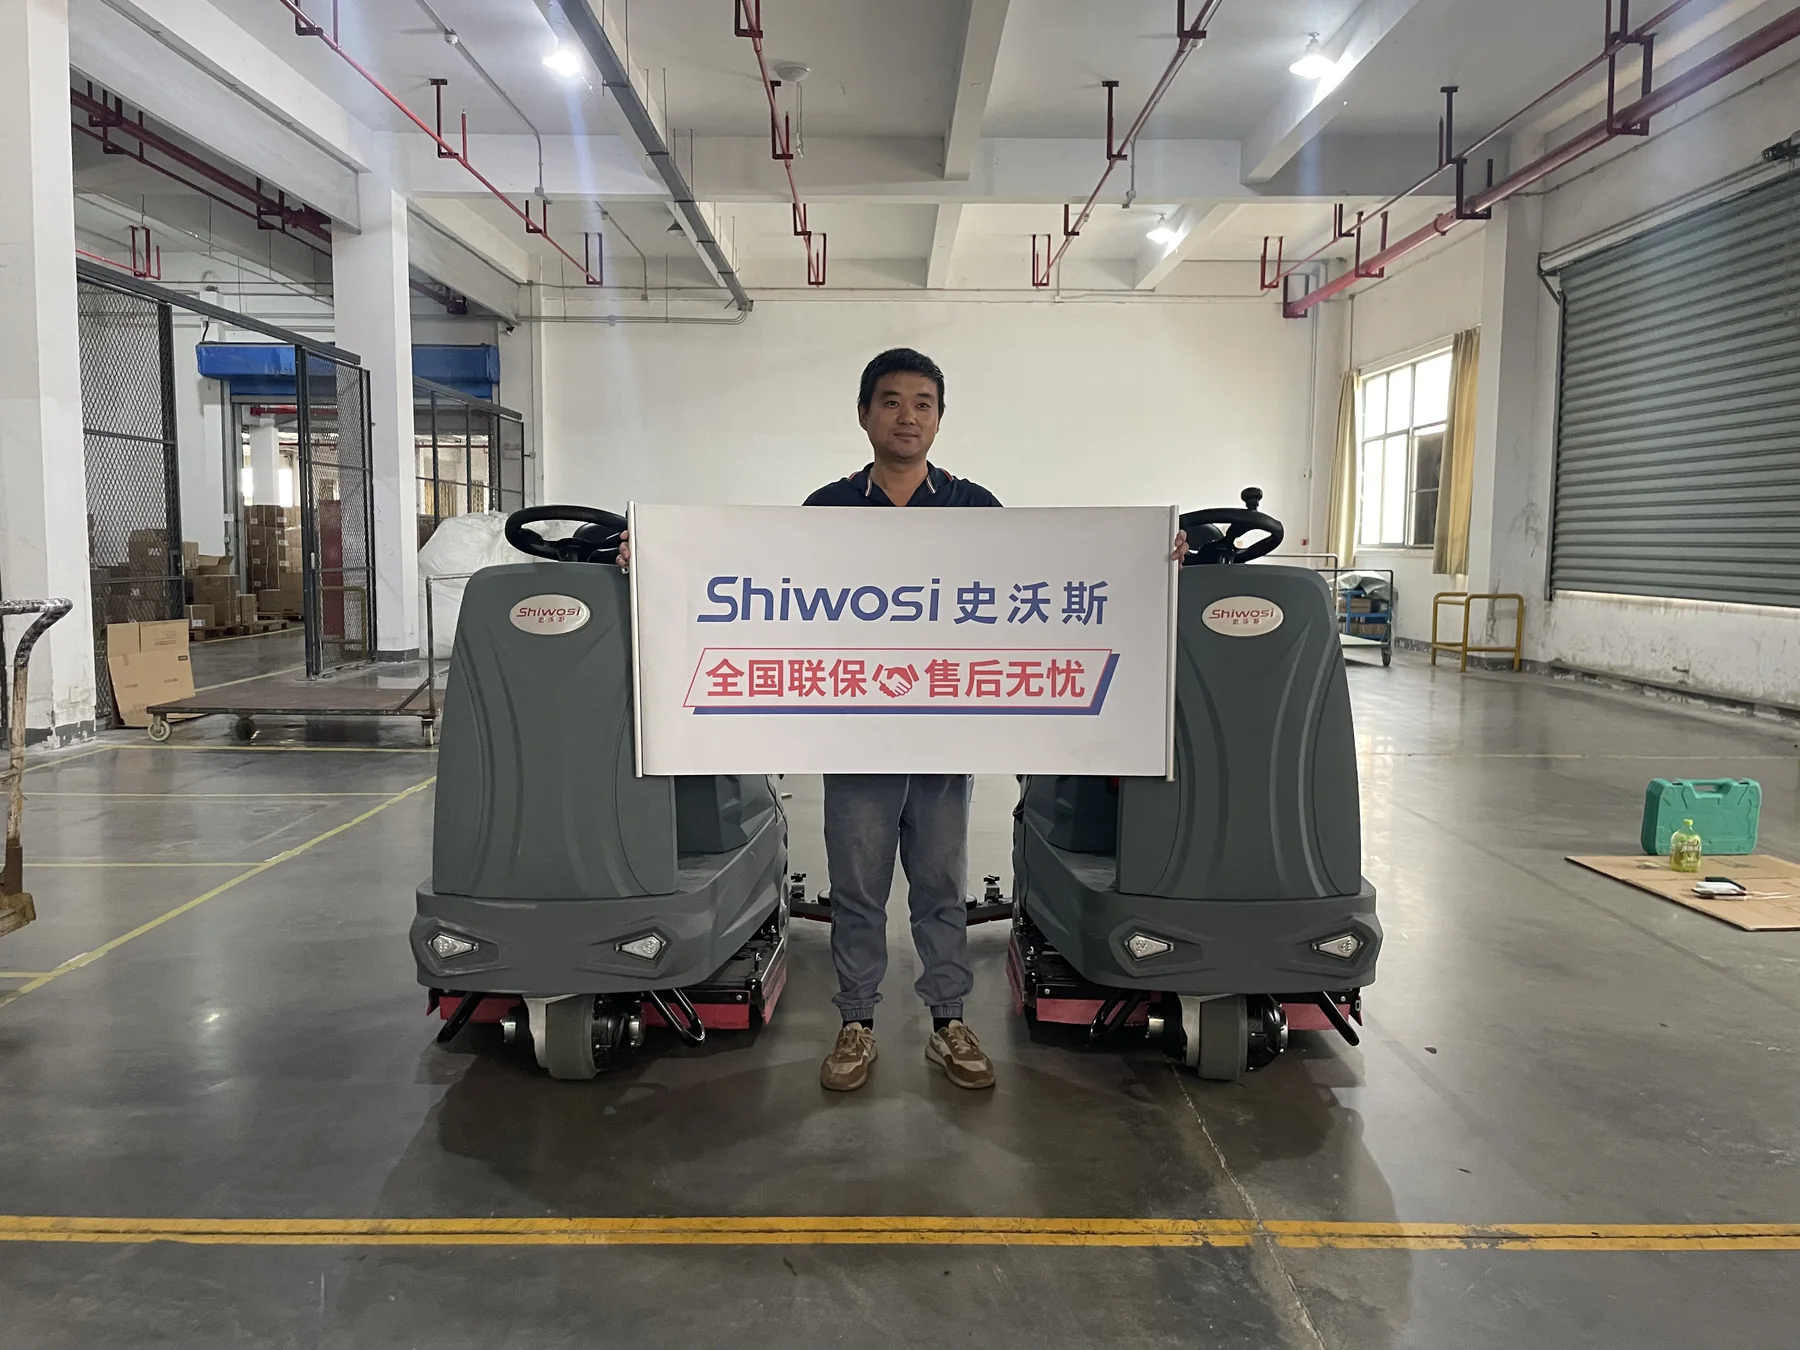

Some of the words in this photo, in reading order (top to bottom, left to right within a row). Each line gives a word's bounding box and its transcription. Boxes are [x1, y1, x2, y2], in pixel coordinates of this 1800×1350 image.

[516, 607, 581, 617] Shiwosi
[697, 576, 940, 623] Shiwosi
[954, 580, 1108, 625] 史沃斯
[1209, 608, 1275, 619] Shiwosi
[705, 657, 868, 698] 全国联保
[924, 658, 1086, 699] 售后无忧
